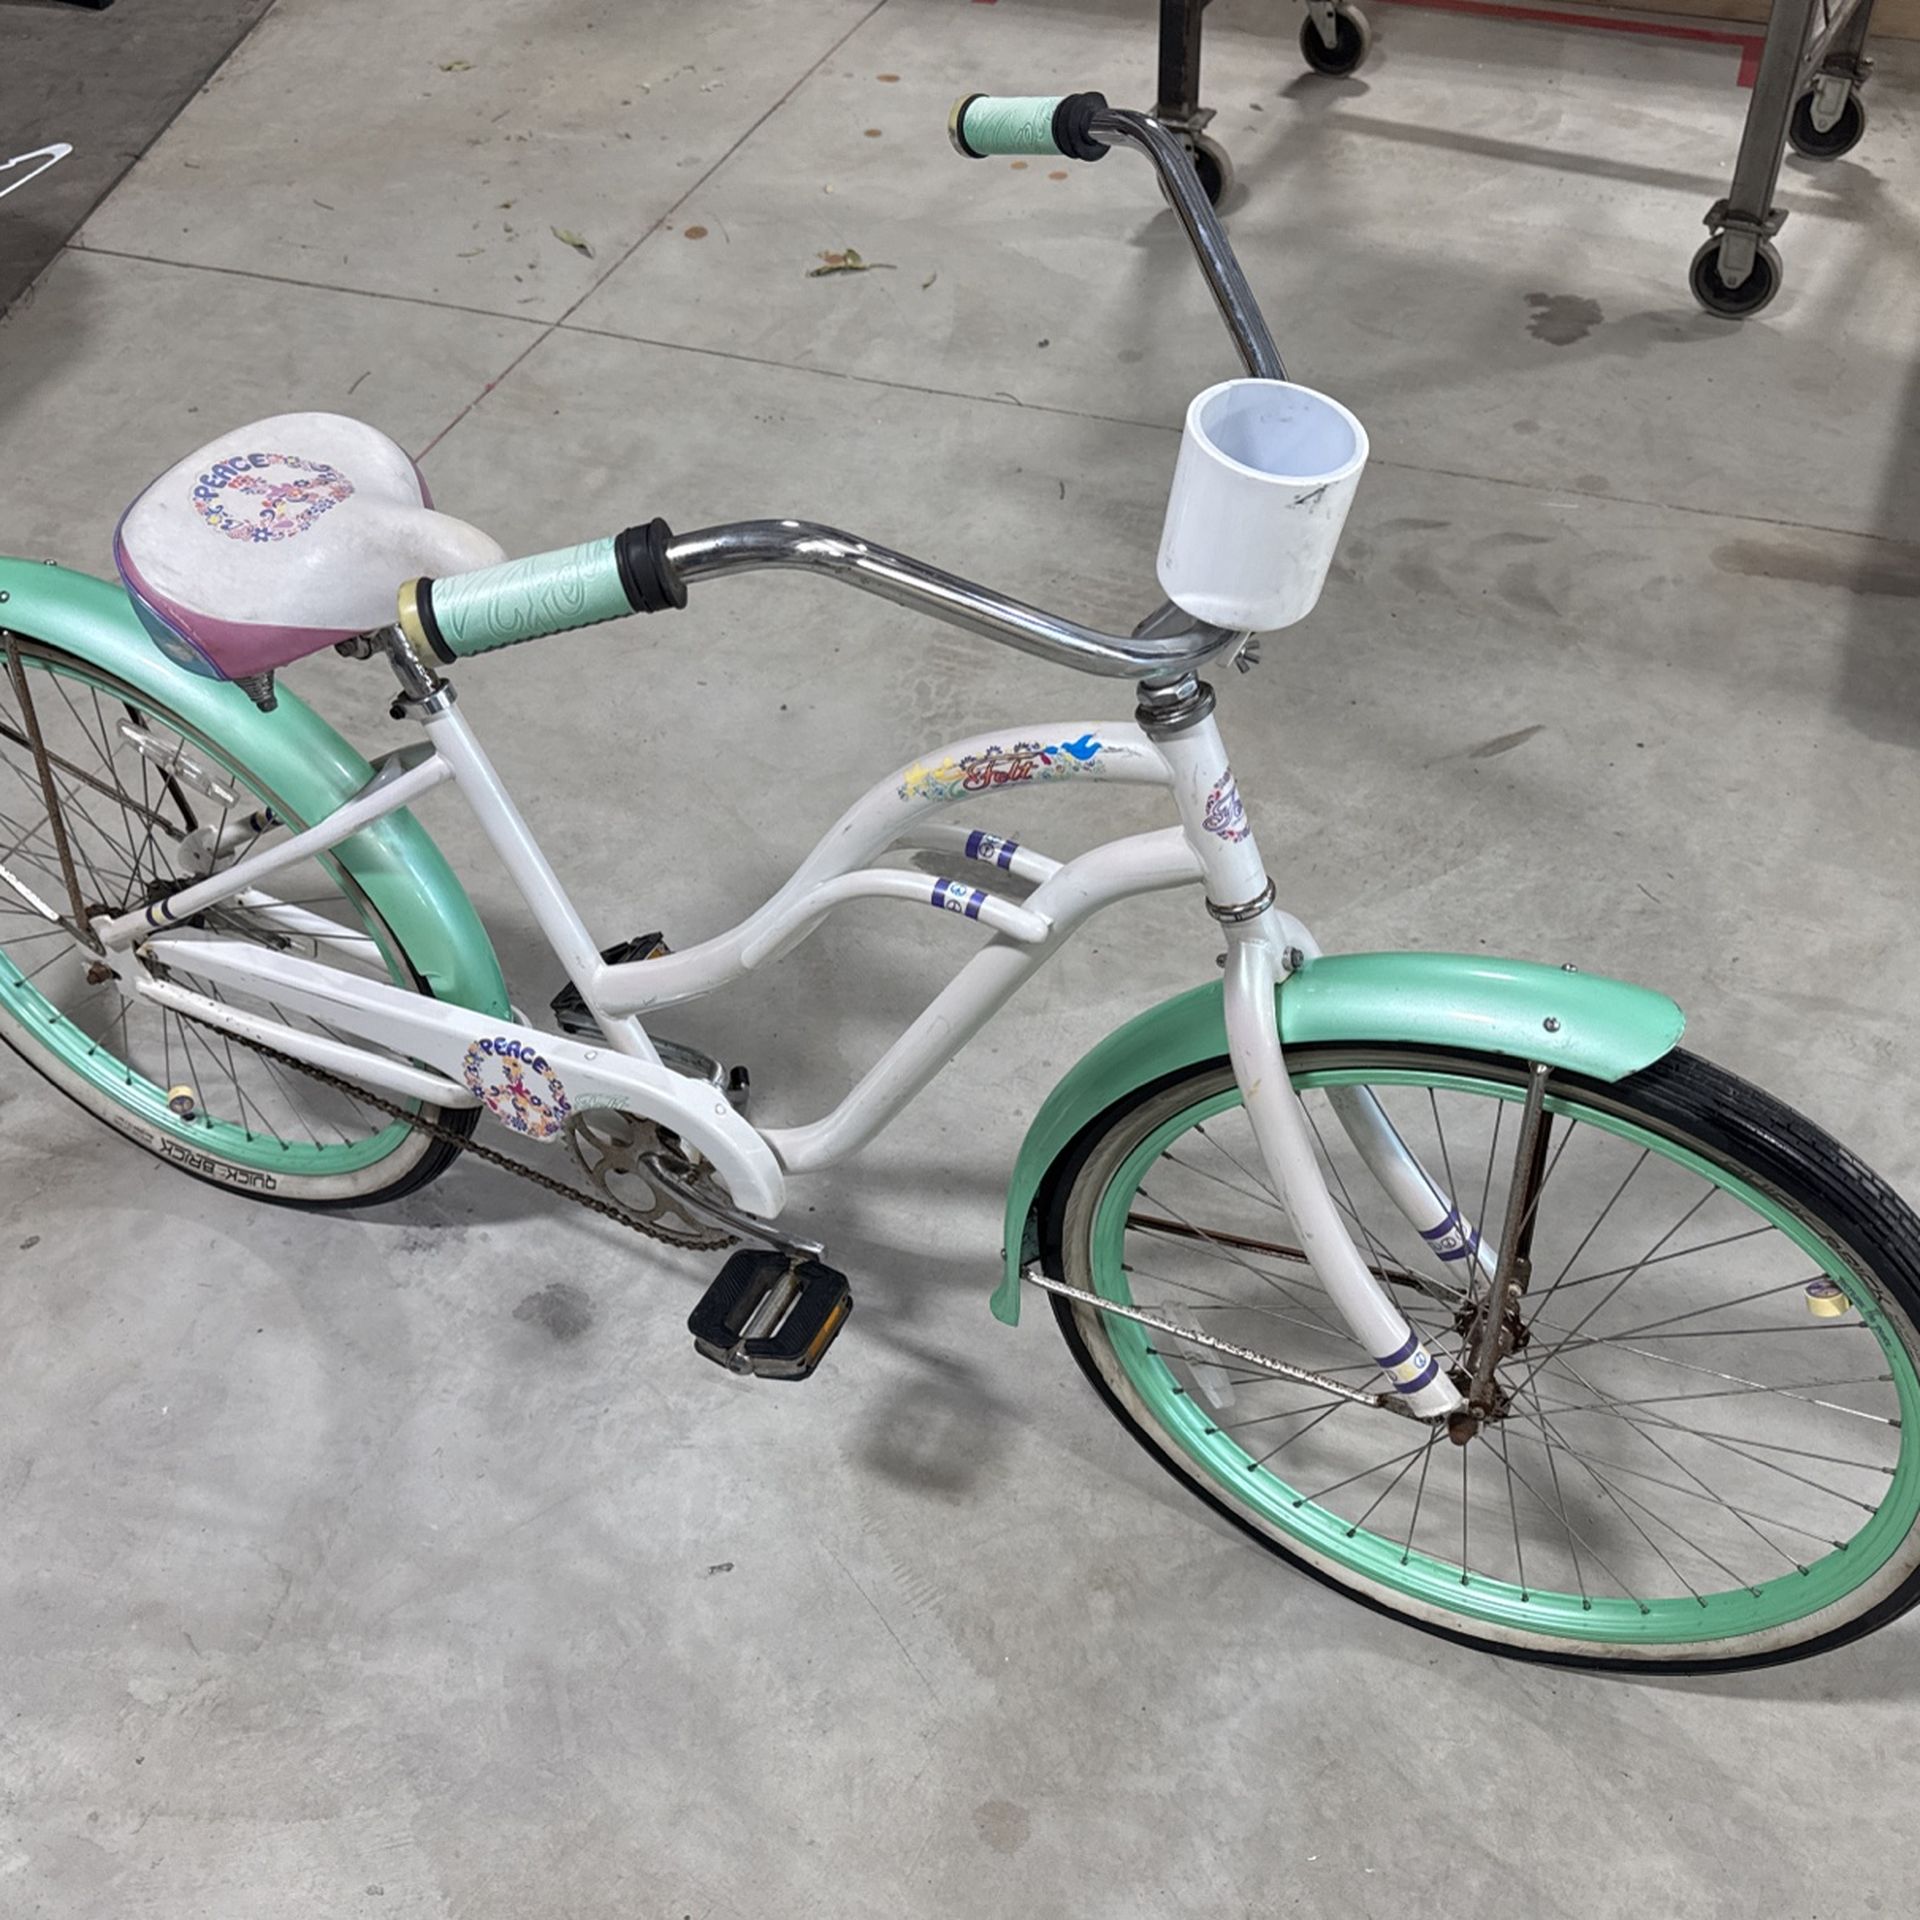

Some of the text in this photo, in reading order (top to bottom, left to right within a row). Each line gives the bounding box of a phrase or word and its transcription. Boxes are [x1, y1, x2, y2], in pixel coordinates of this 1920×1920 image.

[194, 453, 270, 499] PEACE
[479, 1037, 549, 1075] PEACE
[160, 1137, 277, 1191] QUICK BRICK
